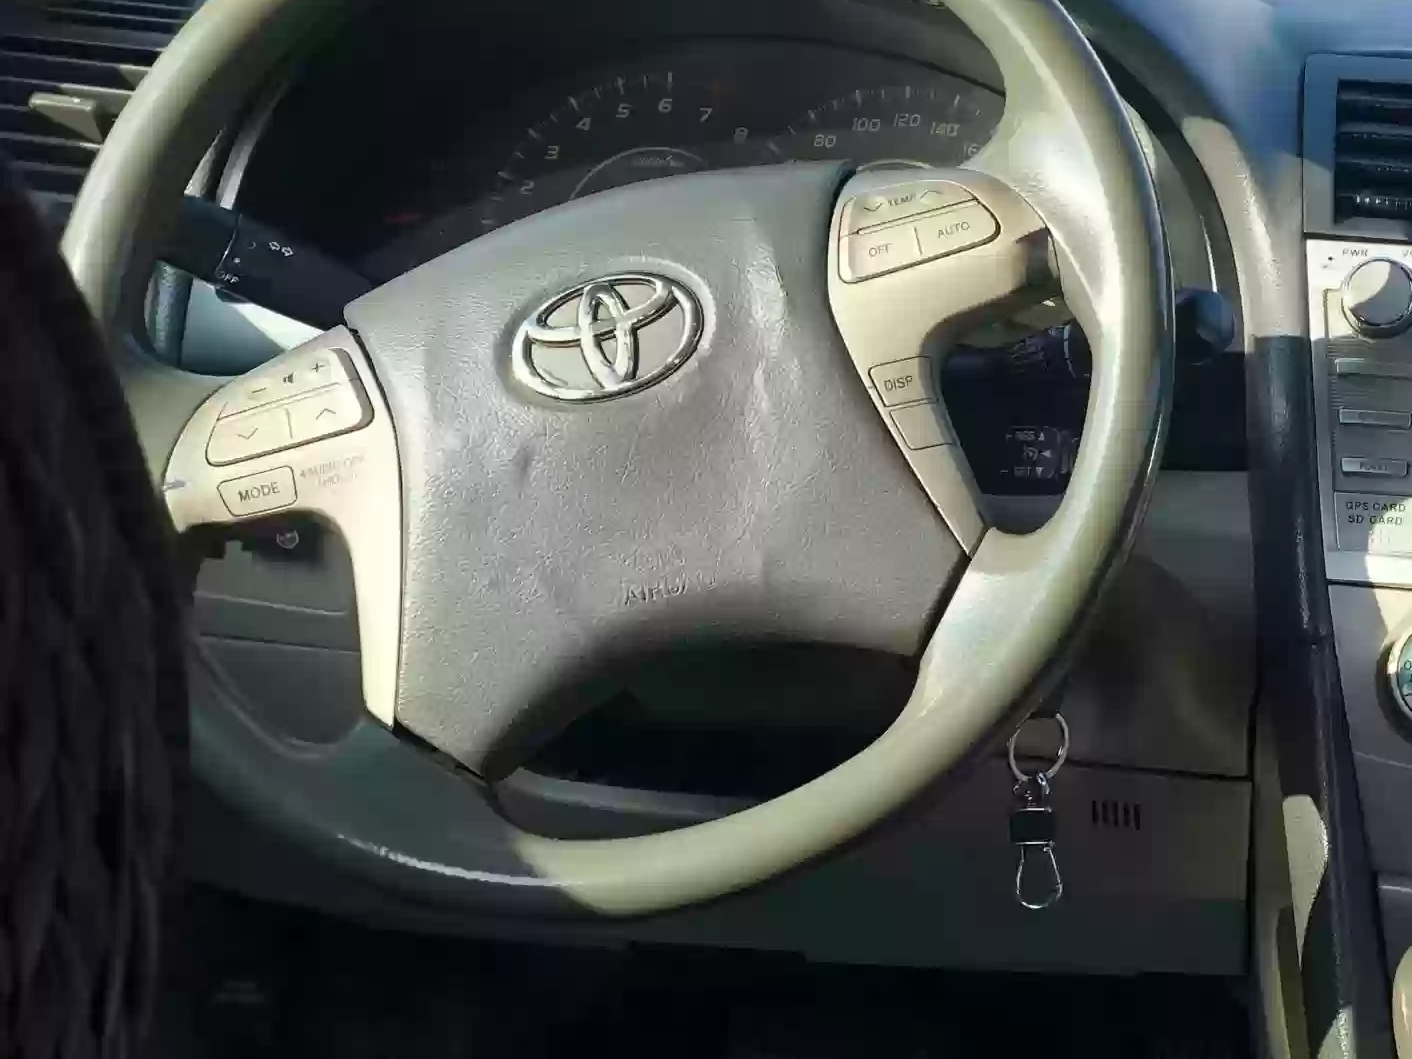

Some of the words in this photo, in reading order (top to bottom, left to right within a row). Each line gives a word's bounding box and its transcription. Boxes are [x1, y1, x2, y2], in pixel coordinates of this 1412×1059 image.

[616, 103, 632, 118] 5
[658, 98, 673, 113] 6
[699, 107, 712, 122] 7
[893, 113, 921, 128] 120
[576, 117, 591, 131] 4
[852, 117, 881, 132] 100
[930, 121, 960, 137] 140
[813, 133, 837, 148] 80
[545, 145, 560, 160] 3
[520, 181, 535, 195] 2
[888, 195, 916, 208] TEMP
[937, 221, 971, 239] AUTO
[868, 242, 893, 258] OFF
[1342, 249, 1369, 258] PWR
[883, 375, 914, 392] DISP
[238, 481, 281, 503] MODE
[1346, 501, 1369, 511] GPS
[1372, 502, 1406, 512] CARD
[1348, 515, 1364, 524] SD
[1369, 515, 1403, 526] CARD
